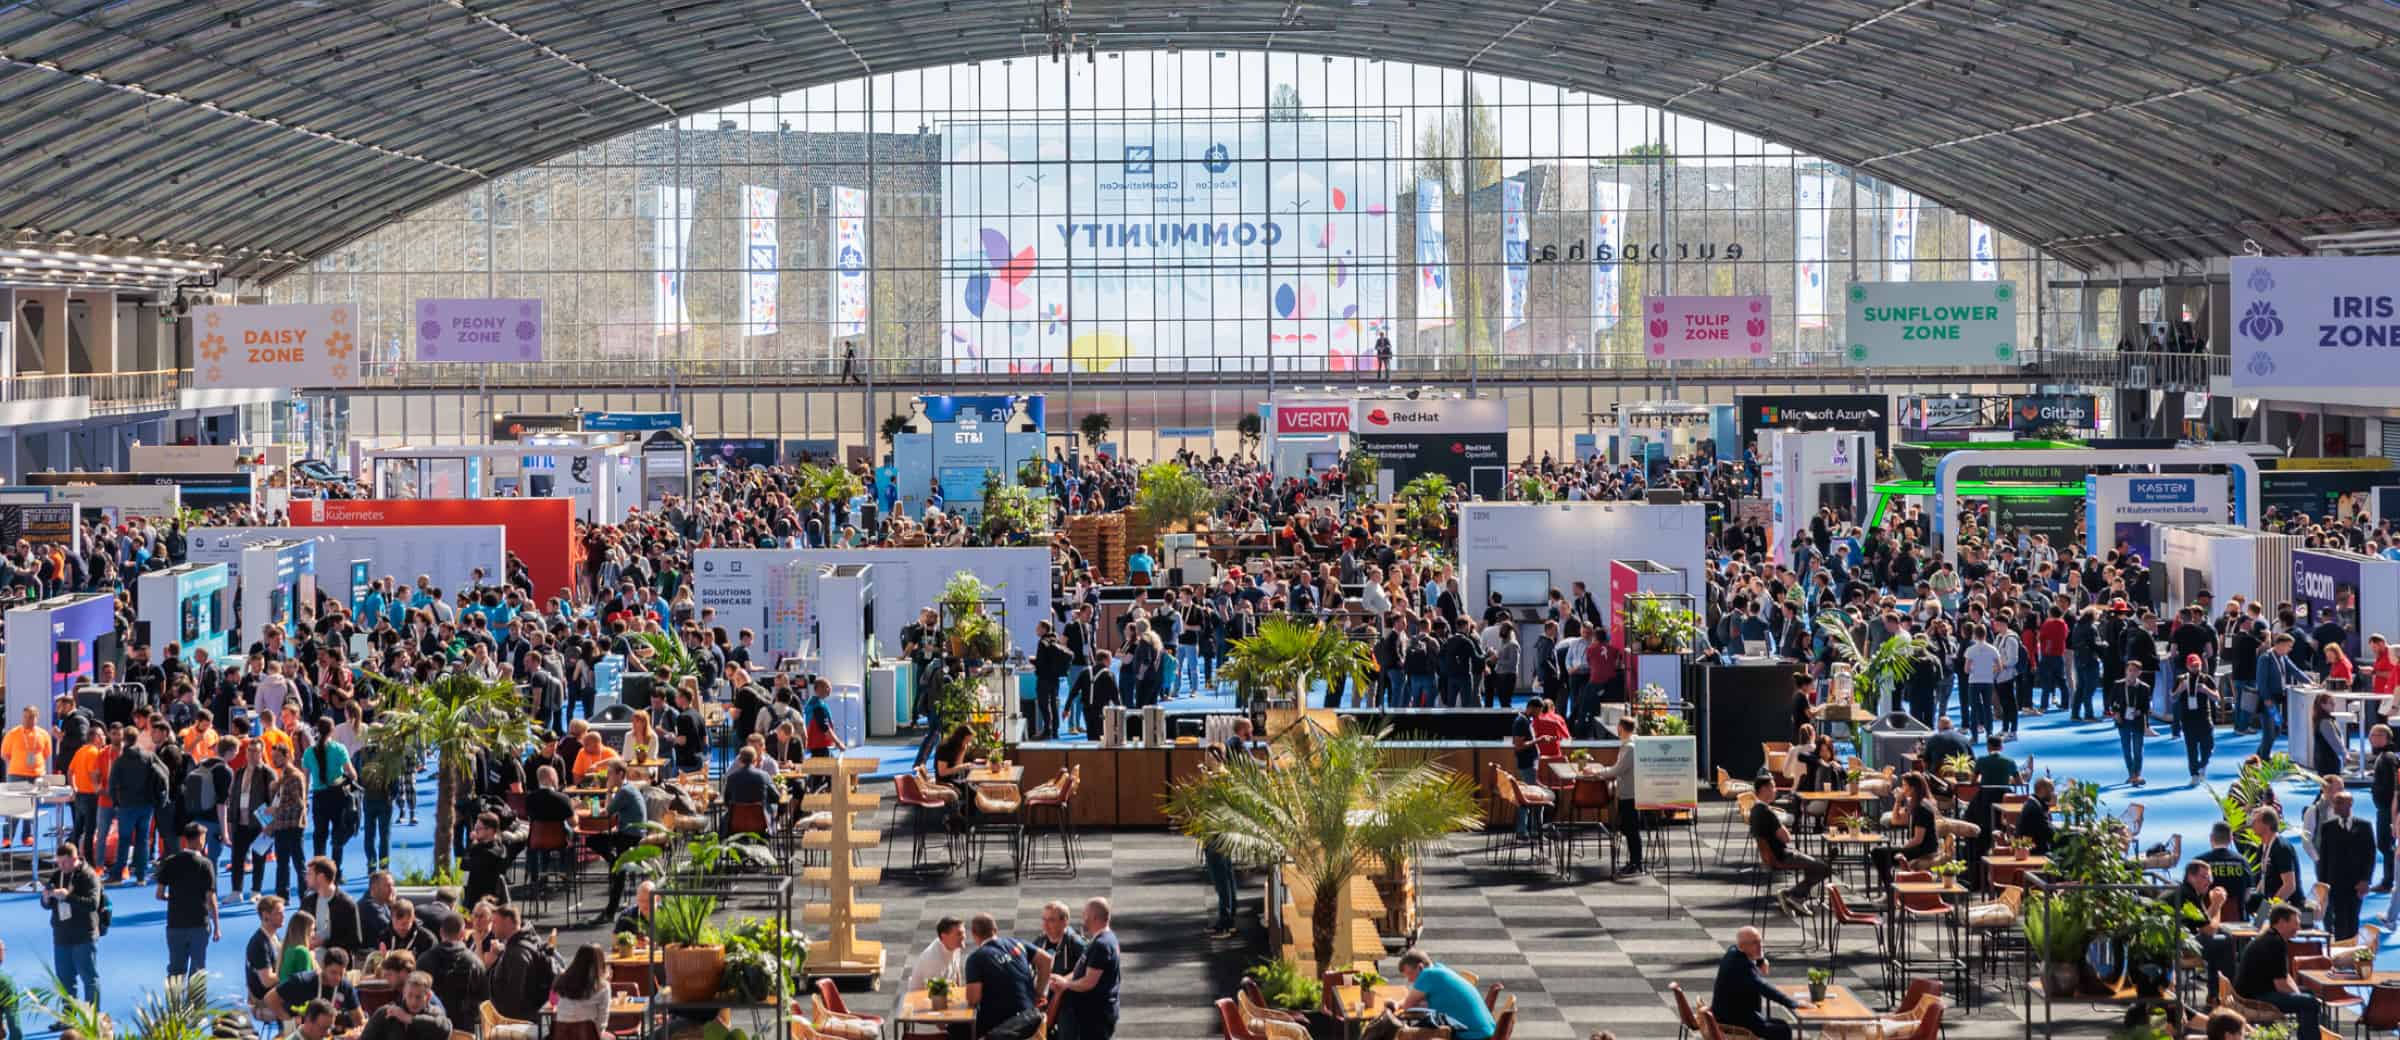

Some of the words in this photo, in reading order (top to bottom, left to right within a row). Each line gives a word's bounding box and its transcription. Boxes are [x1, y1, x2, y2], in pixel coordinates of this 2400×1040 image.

[1864, 306, 1998, 321] SUNFLOWER
[2333, 296, 2394, 318] IRIS
[452, 316, 506, 330] PEONY
[1685, 314, 1730, 326] TULIP
[244, 329, 307, 345] DAISY
[457, 330, 502, 344] ZONE
[1685, 328, 1729, 340] ZONE
[1903, 325, 1961, 340] ZONE
[2319, 325, 2400, 347] ZONE
[247, 346, 305, 363] ZONE
[991, 408, 1014, 422] aw
[1284, 411, 1349, 428] VERITA
[1393, 411, 1416, 422] Red
[1418, 411, 1439, 422] Hat
[1781, 408, 1834, 420] Microft
[1836, 408, 1867, 420] Azur
[2040, 406, 2085, 420] GitLab
[1408, 442, 1419, 450] for
[1979, 466, 2021, 478] SECURITY
[2023, 466, 2048, 478] BUILT
[2050, 466, 2062, 478] IN
[2136, 483, 2187, 493] KASTEN
[326, 511, 385, 521] Kubernetes
[2177, 505, 2208, 514] Backup
[702, 588, 752, 596] SOLUTIONS
[2211, 864, 2243, 877] HERO
